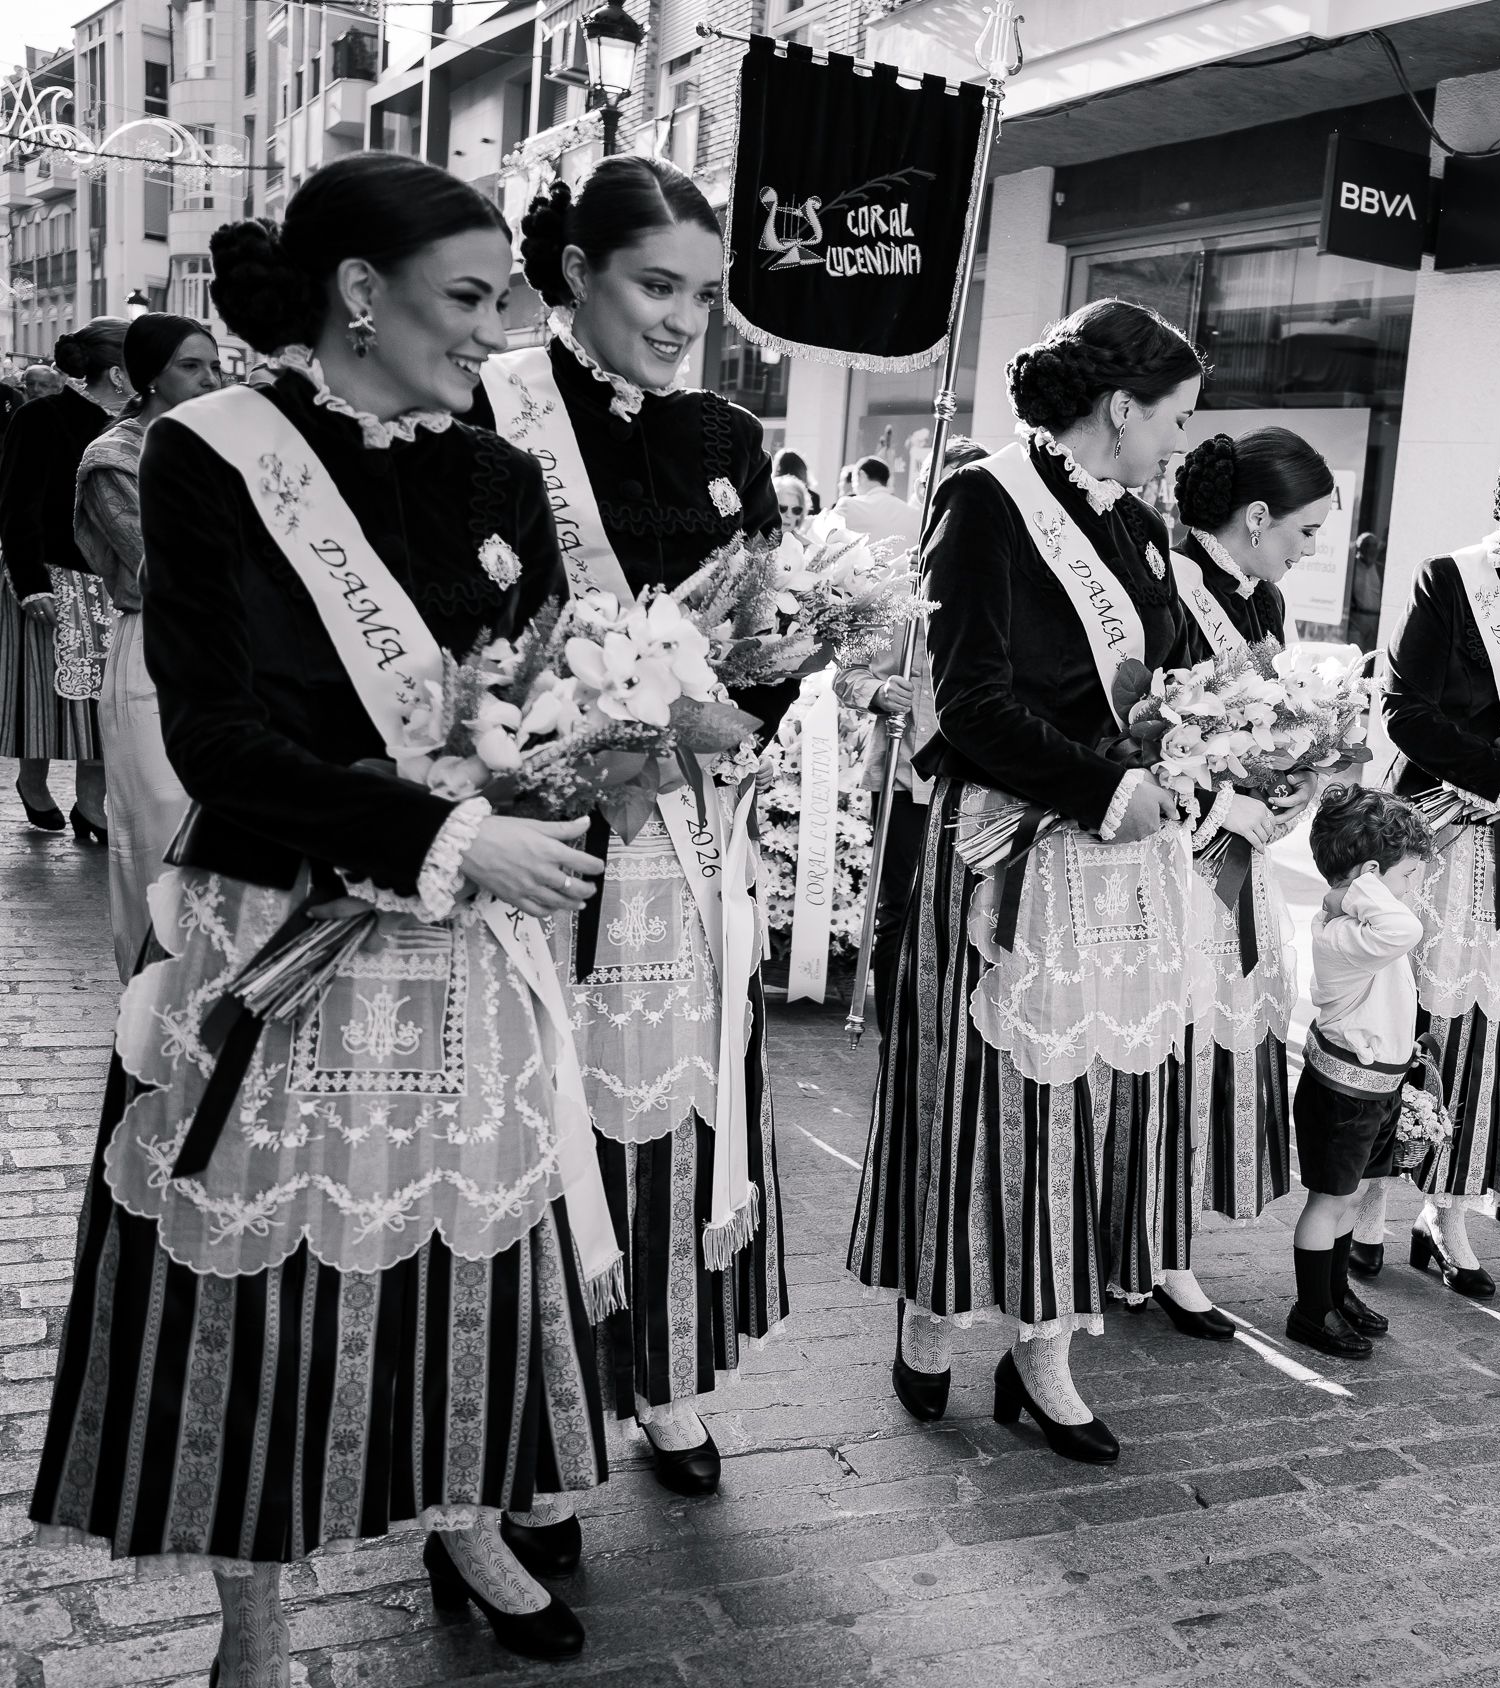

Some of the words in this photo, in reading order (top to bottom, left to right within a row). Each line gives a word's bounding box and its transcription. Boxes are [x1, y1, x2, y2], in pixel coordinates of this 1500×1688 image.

[846, 202, 915, 238] CORAL
[1340, 181, 1417, 221] BBVA
[825, 241, 922, 277] LUCENTINA
[309, 538, 408, 671] DAMA
[1067, 559, 1127, 650] DAMA
[808, 736, 832, 841] LUCENTINA
[686, 818, 723, 878] 2026
[805, 846, 829, 906] CORAL
